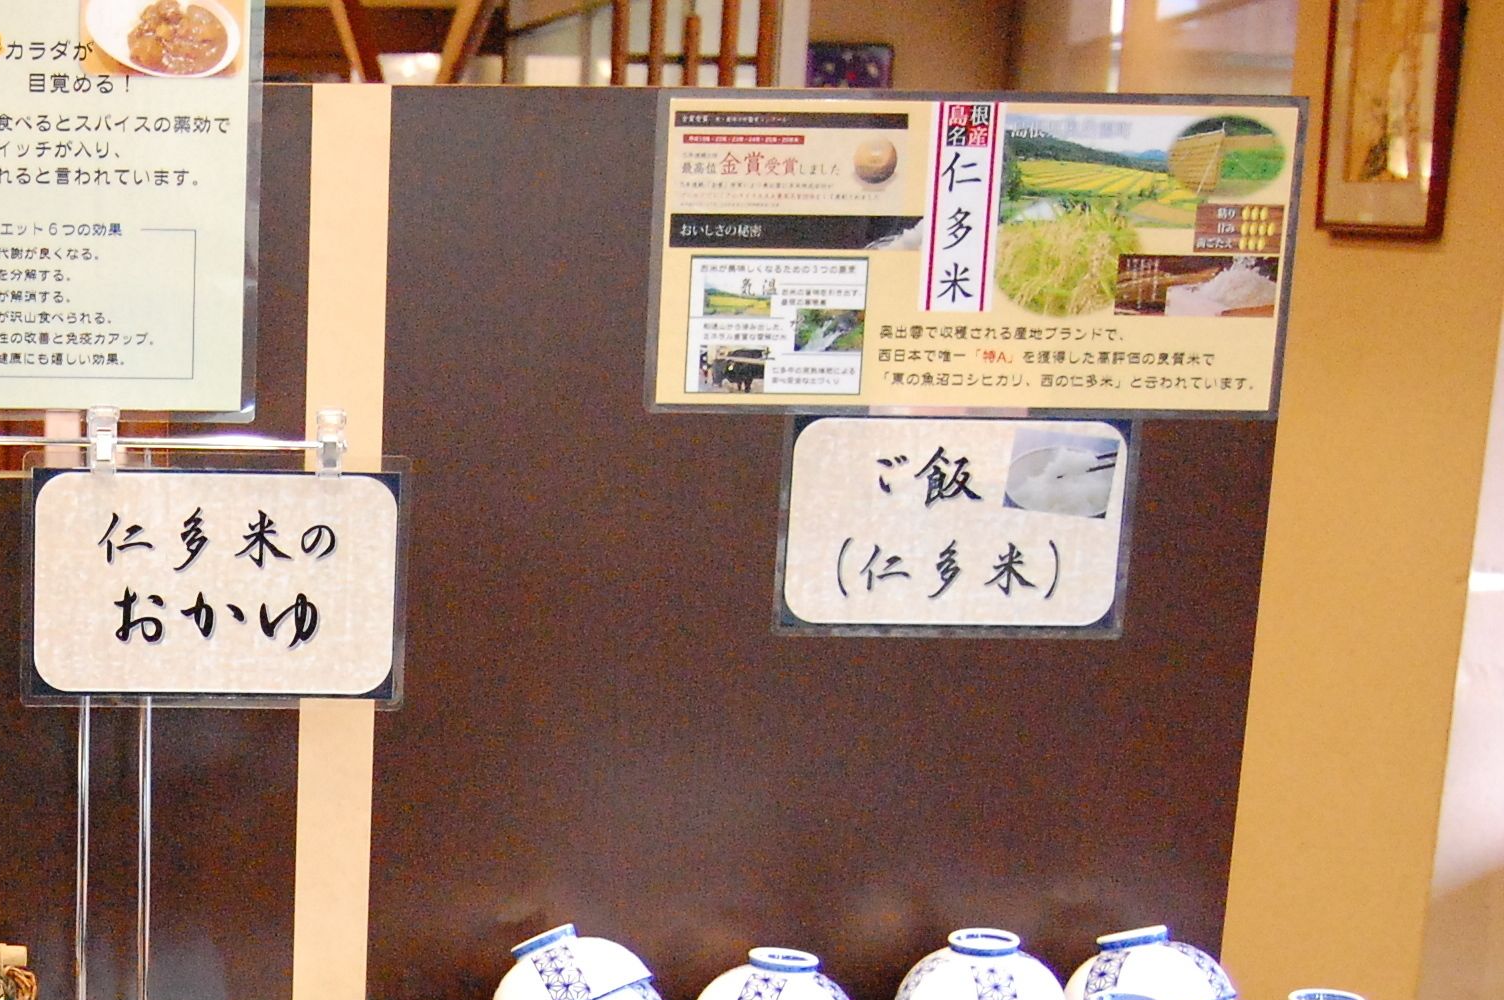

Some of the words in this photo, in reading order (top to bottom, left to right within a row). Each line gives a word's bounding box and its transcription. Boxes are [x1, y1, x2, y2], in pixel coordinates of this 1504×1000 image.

[28, 73, 132, 94] 目覚める！
[680, 223, 763, 238] おいしさの秘密
[936, 151, 982, 305] 仁多米
[877, 446, 983, 508] ご飯
[98, 506, 337, 571] 仁多米の
[837, 538, 1060, 599] （仁多米）
[113, 586, 319, 649] おかゆ
